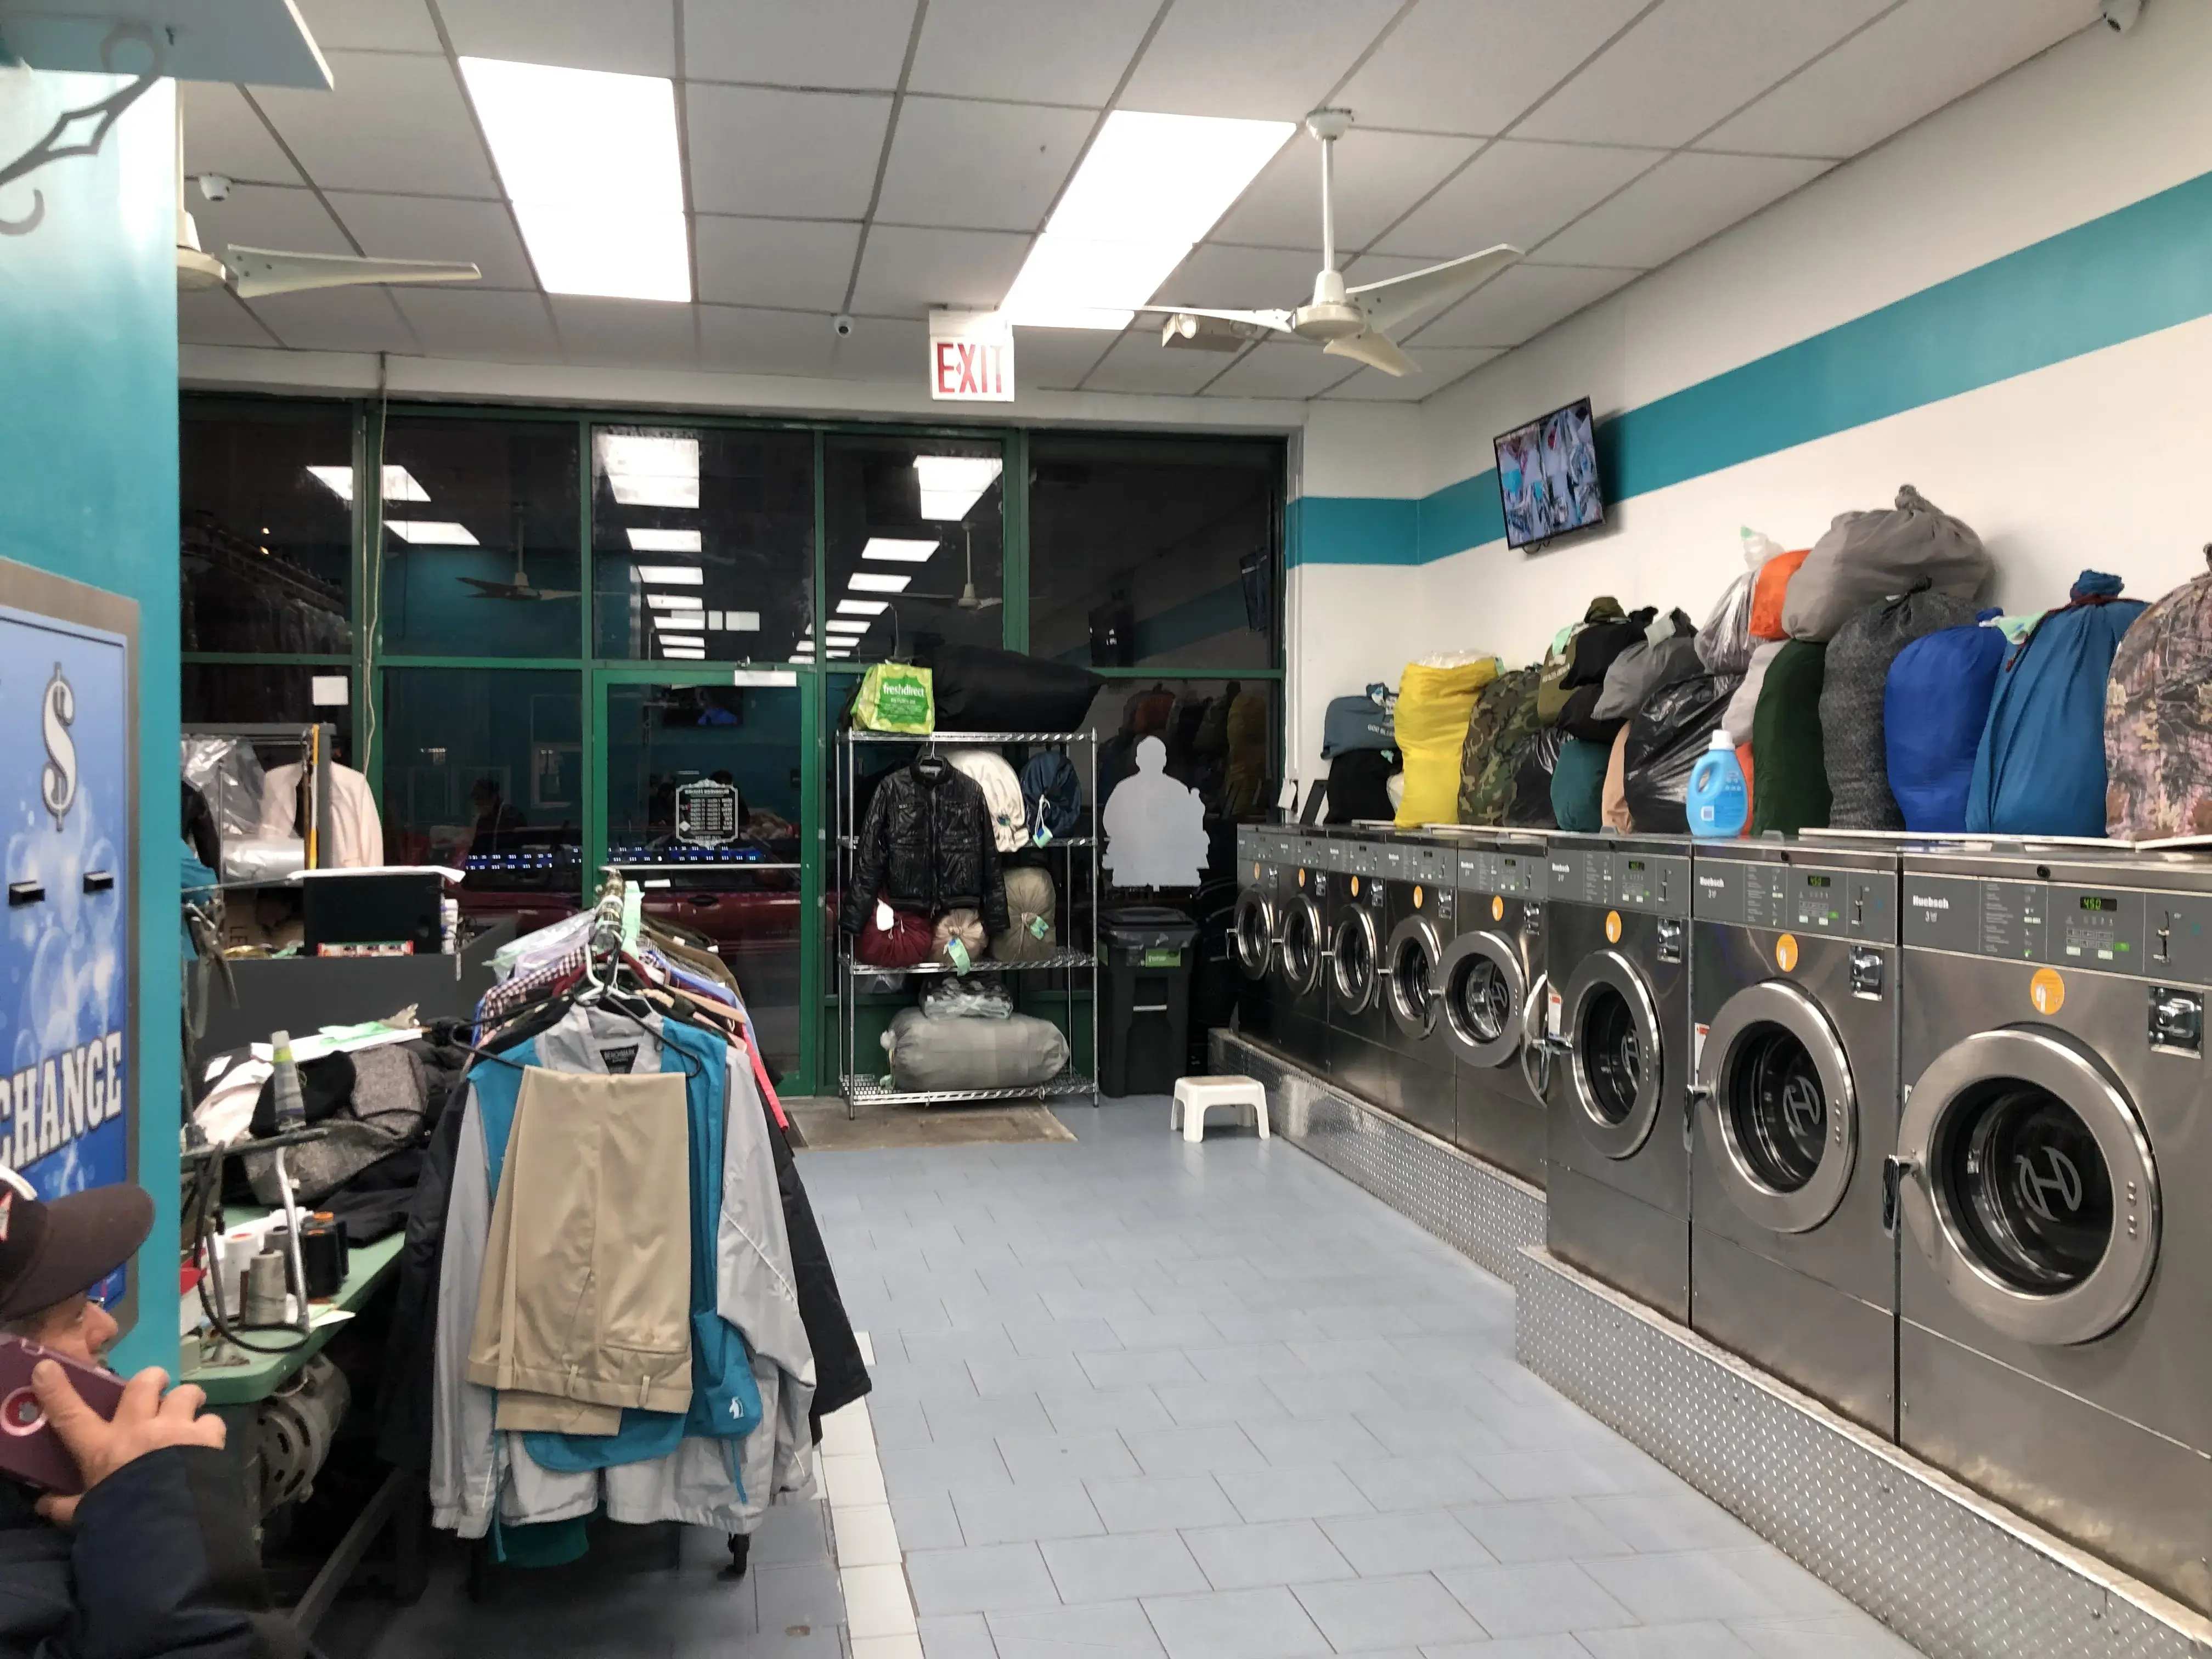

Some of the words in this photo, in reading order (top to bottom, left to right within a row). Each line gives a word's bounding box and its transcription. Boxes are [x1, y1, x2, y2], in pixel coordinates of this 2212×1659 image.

[937, 342, 1003, 393] EXIT
[883, 682, 924, 698] freshdirect
[1912, 894, 1949, 909] Huebsch
